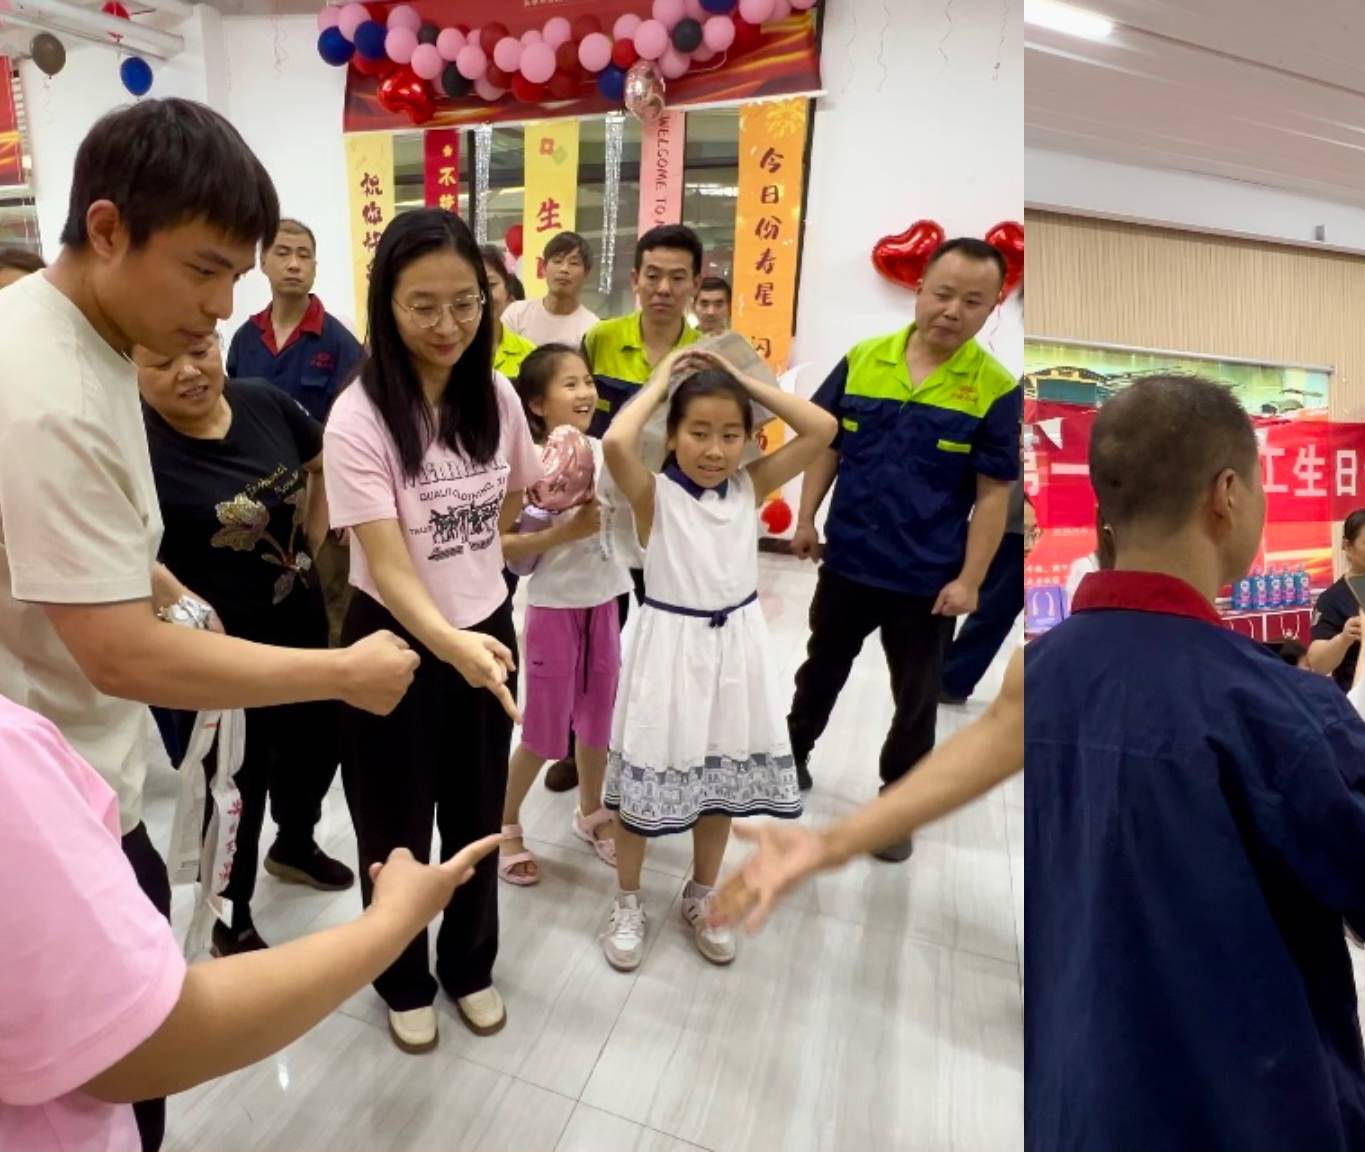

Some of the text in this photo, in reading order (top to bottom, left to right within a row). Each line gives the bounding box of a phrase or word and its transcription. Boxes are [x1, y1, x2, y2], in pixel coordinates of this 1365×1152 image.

[654, 116, 671, 216] WELCOME TO
[754, 147, 784, 306] 今日份寿星
